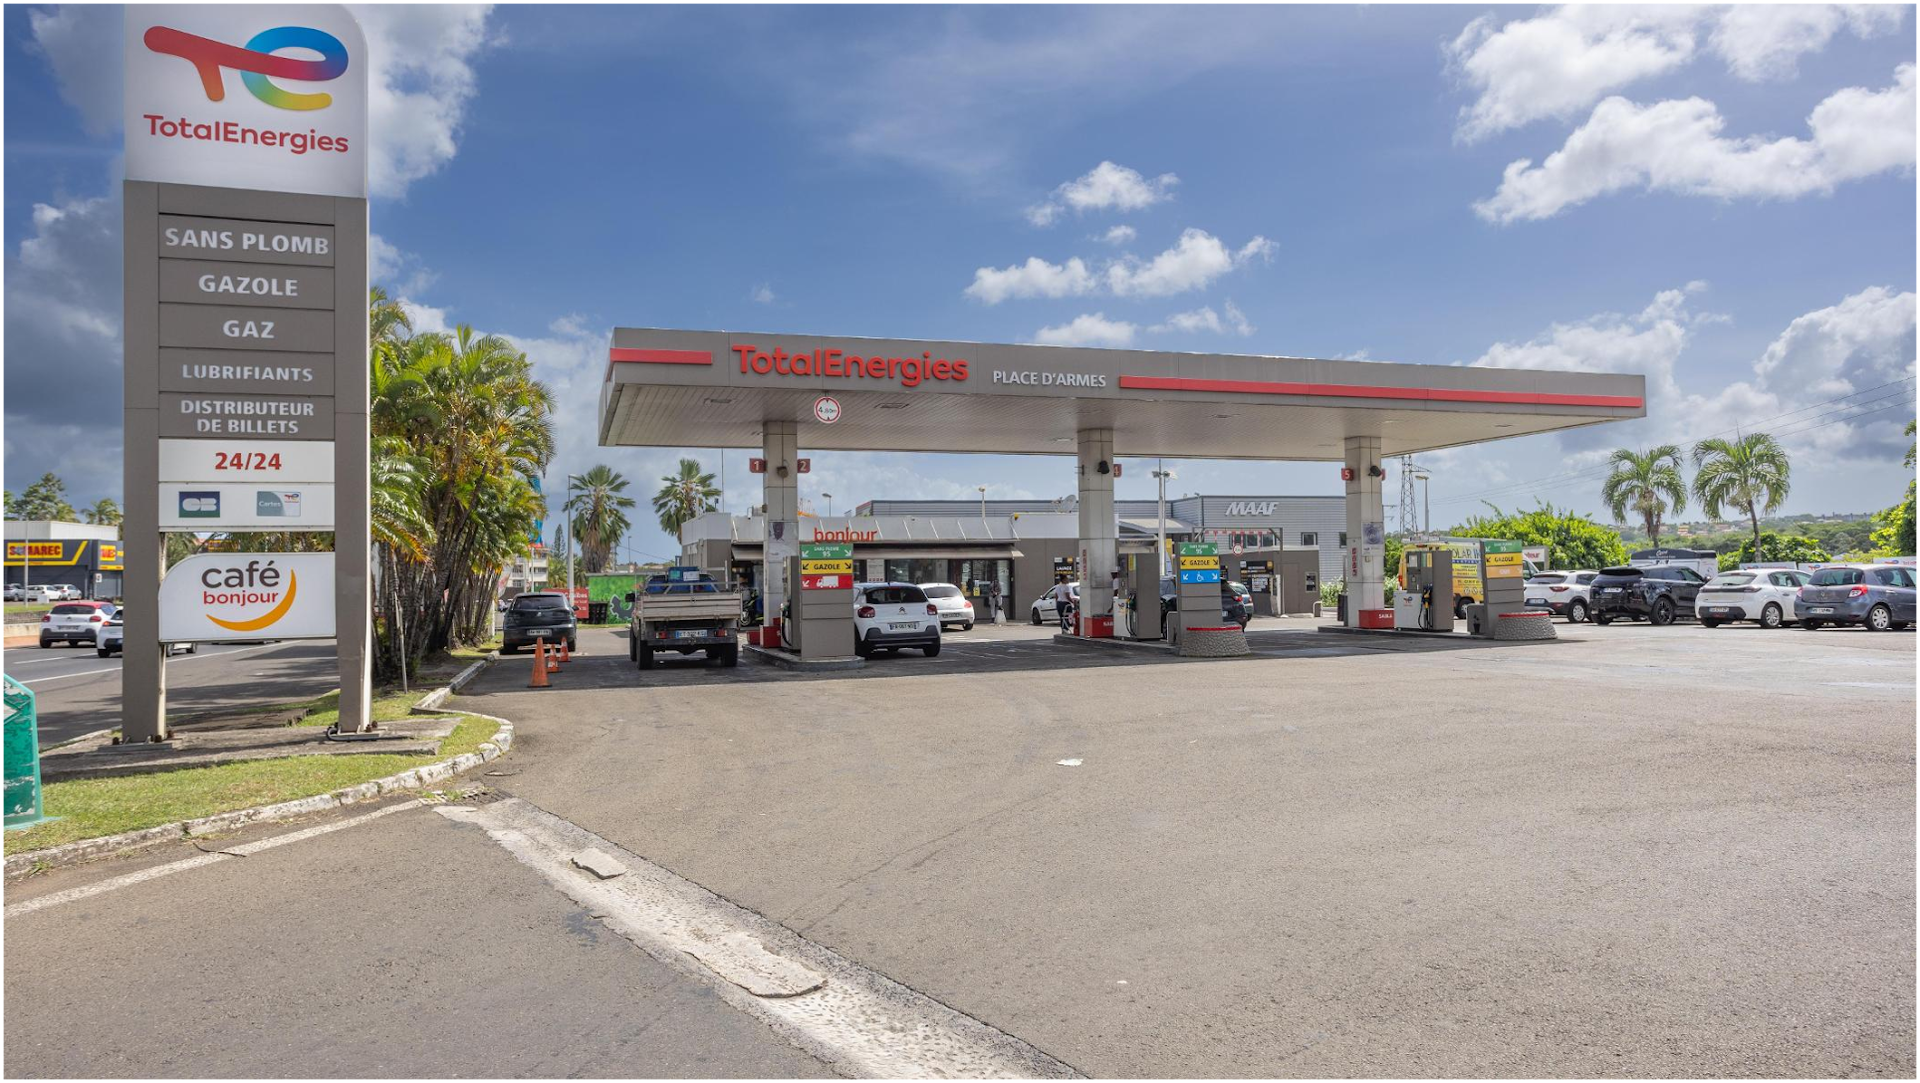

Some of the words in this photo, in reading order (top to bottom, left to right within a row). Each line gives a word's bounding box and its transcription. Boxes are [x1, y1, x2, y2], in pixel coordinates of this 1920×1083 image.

[143, 114, 349, 155] TotalEnergies
[165, 227, 234, 250] SANS
[242, 233, 329, 255] PLOMB
[198, 274, 298, 297] GAZOLE
[223, 320, 275, 339] GAZ
[182, 364, 313, 382] LUBRIFIANTS
[732, 345, 969, 387] TotalEnergies
[993, 371, 1039, 386] PLACE
[1042, 373, 1106, 388] D'ARMES
[181, 400, 314, 416] DISTRIBUTEUR
[197, 419, 222, 433] DE
[228, 420, 299, 434] BILLETS
[215, 452, 282, 471] 24/24
[753, 461, 760, 471] 1
[799, 461, 808, 472] 2
[1225, 502, 1280, 516] MAAF
[814, 526, 878, 544] bonjour
[202, 560, 280, 589] café
[203, 590, 279, 607] bonjour
